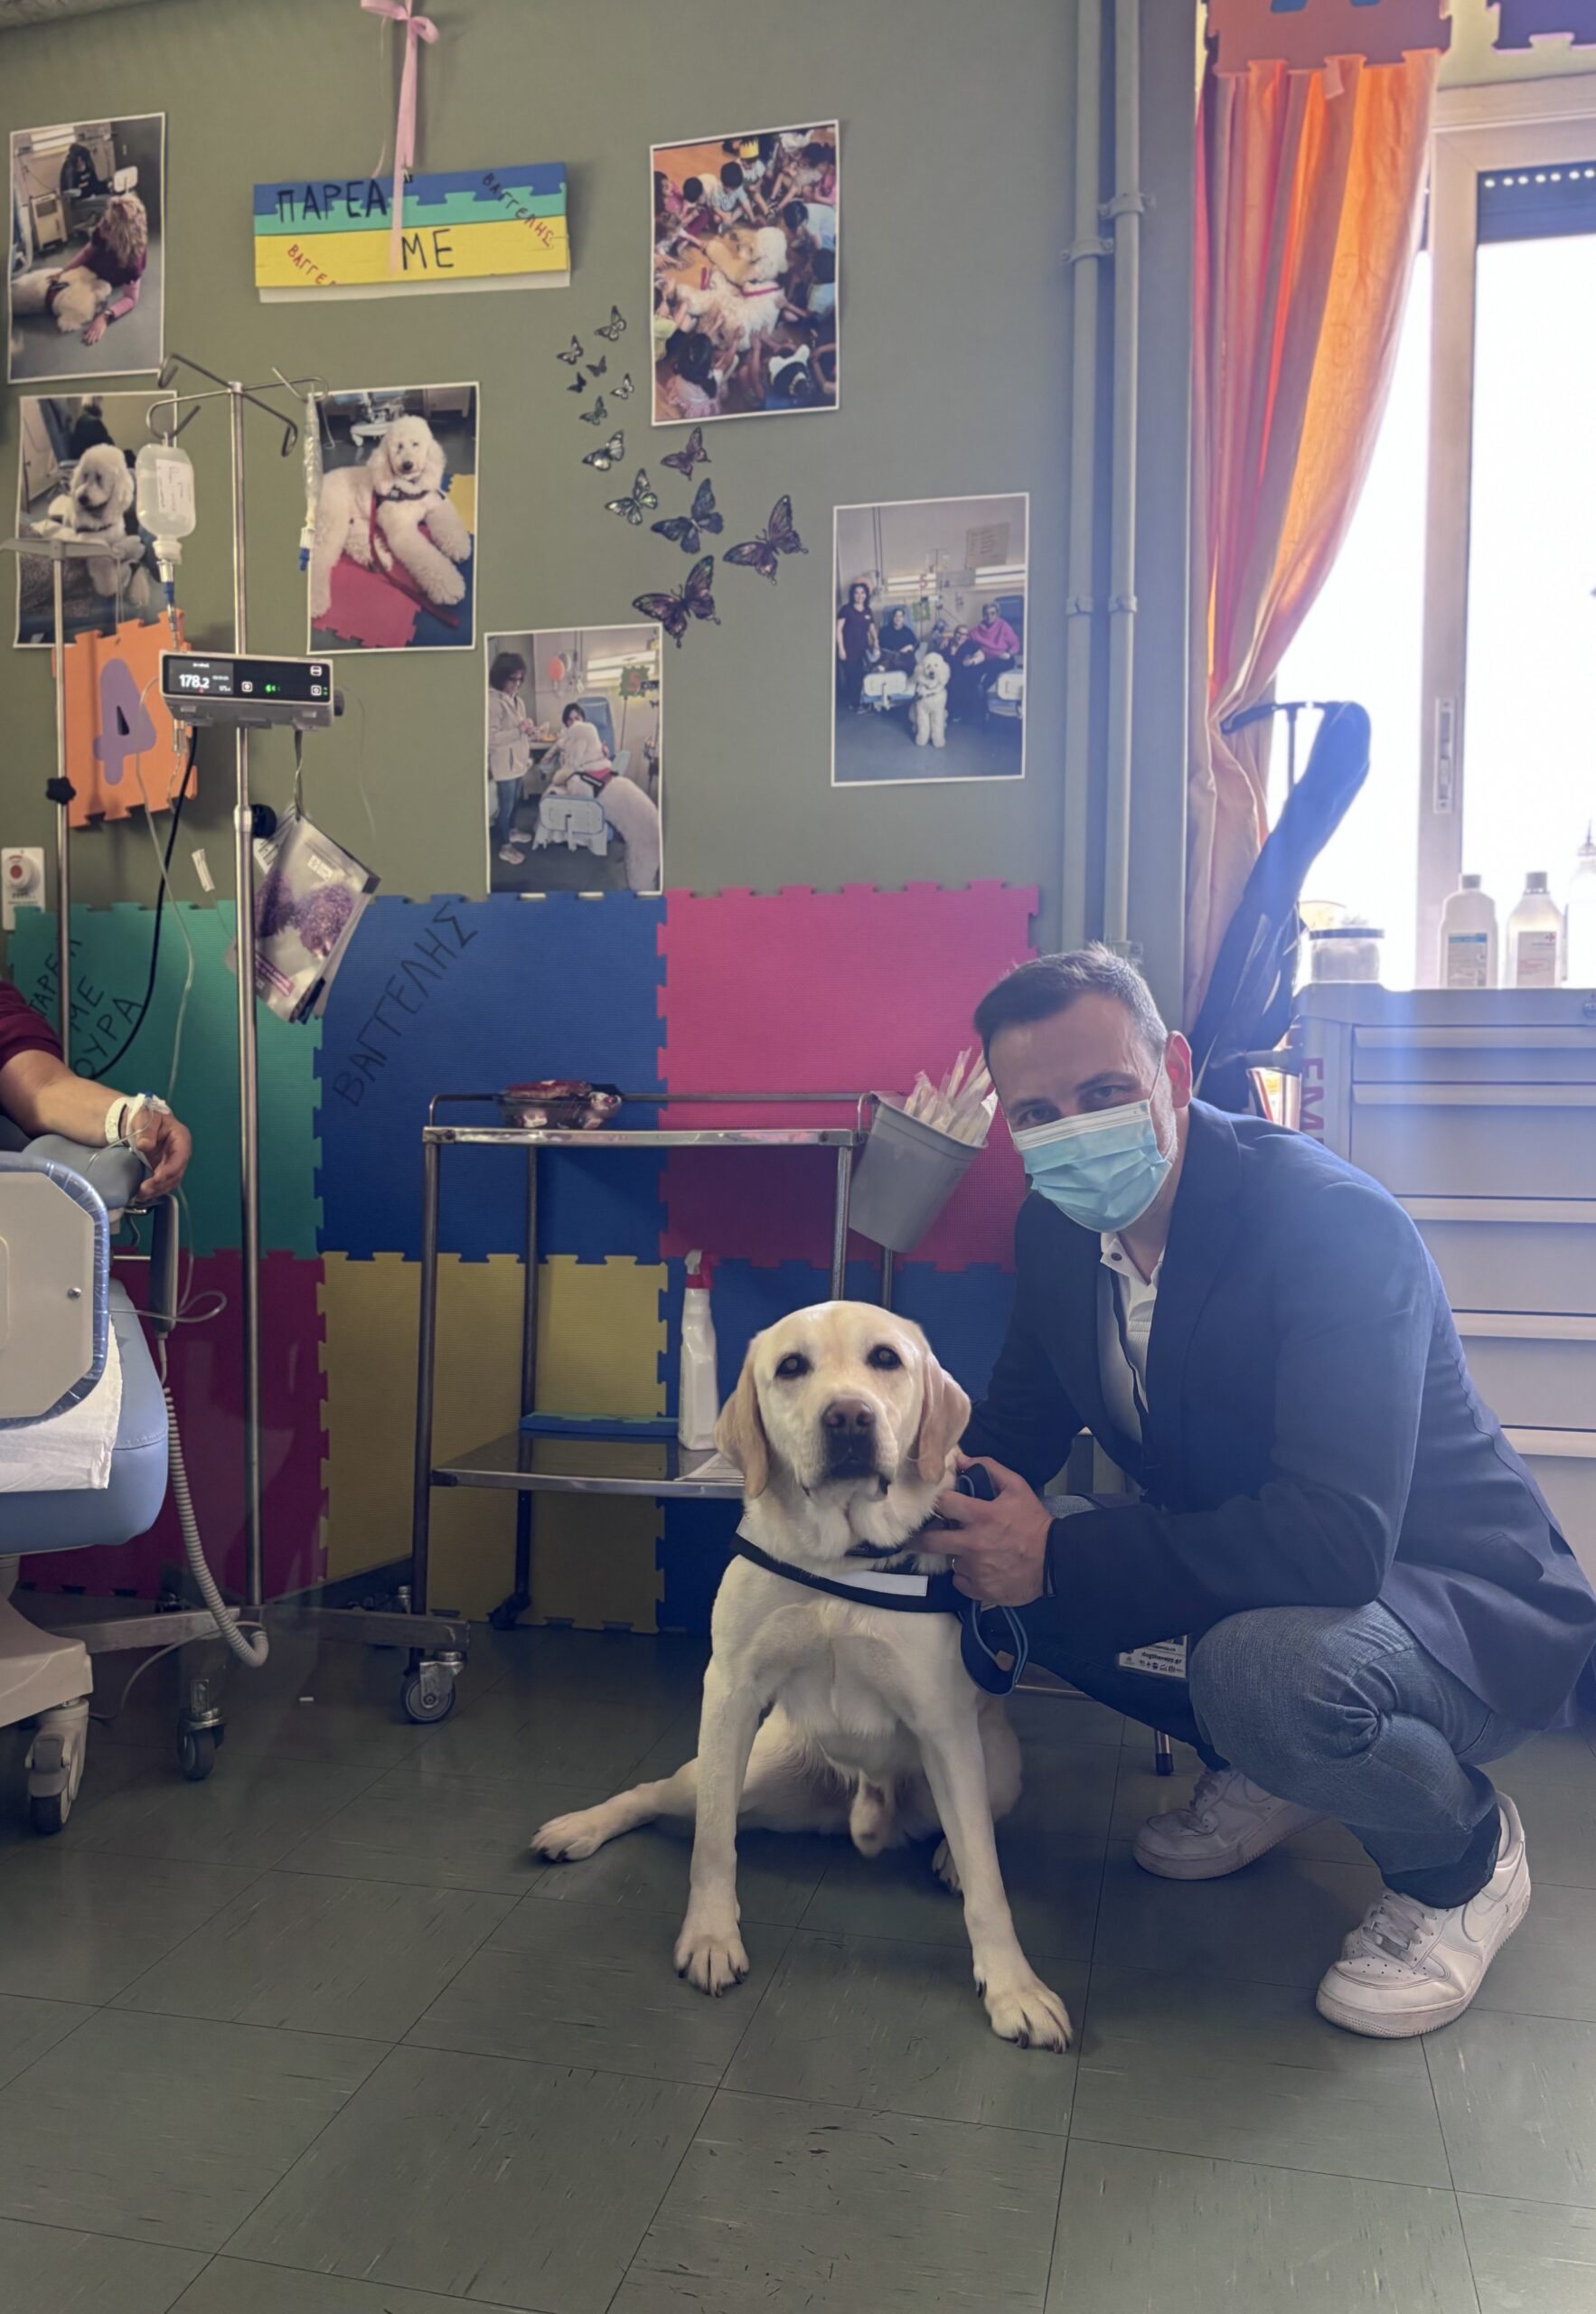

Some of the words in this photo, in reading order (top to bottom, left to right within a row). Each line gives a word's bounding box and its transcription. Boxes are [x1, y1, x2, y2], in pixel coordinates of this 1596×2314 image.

[277, 178, 388, 223] ΠΑΡΕΑ
[482, 172, 556, 249] ΒΑΓΓΕΛΗΣ
[401, 229, 455, 271] ΜΕ
[179, 673, 211, 690] 178.2
[332, 901, 479, 1107] ΒΑΓΓΕΛΗΣ
